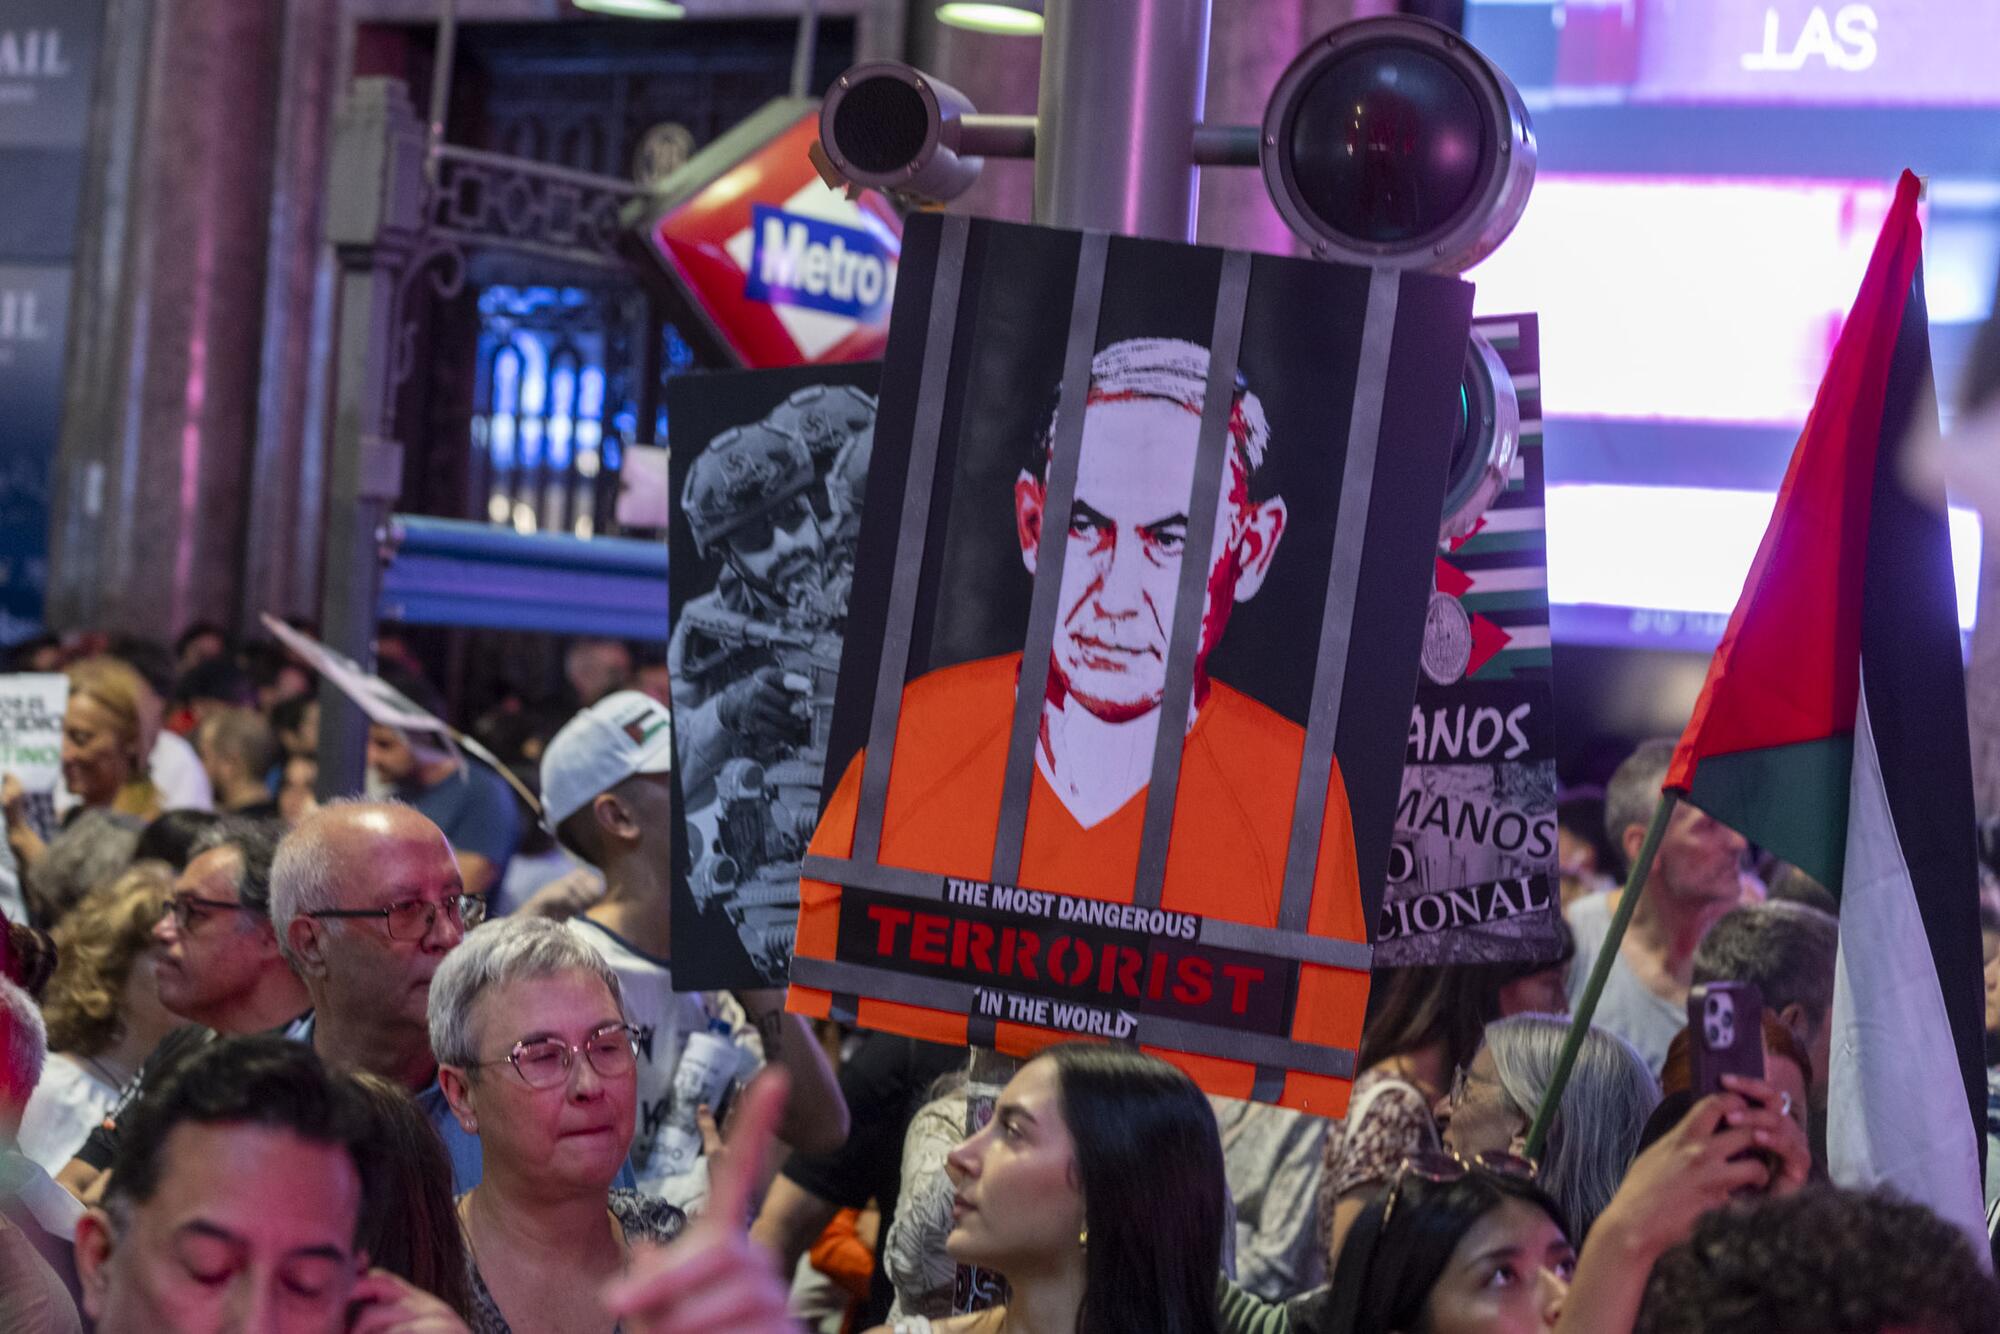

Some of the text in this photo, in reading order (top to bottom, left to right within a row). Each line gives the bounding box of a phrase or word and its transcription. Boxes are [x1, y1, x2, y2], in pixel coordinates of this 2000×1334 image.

[760, 217, 884, 305] Metro
[947, 878, 1197, 939] THE MOST DANGEROUS
[867, 904, 1265, 1015] TERRORIST
[1007, 995, 1050, 1025] THE
[1052, 1000, 1134, 1039] WORLD
